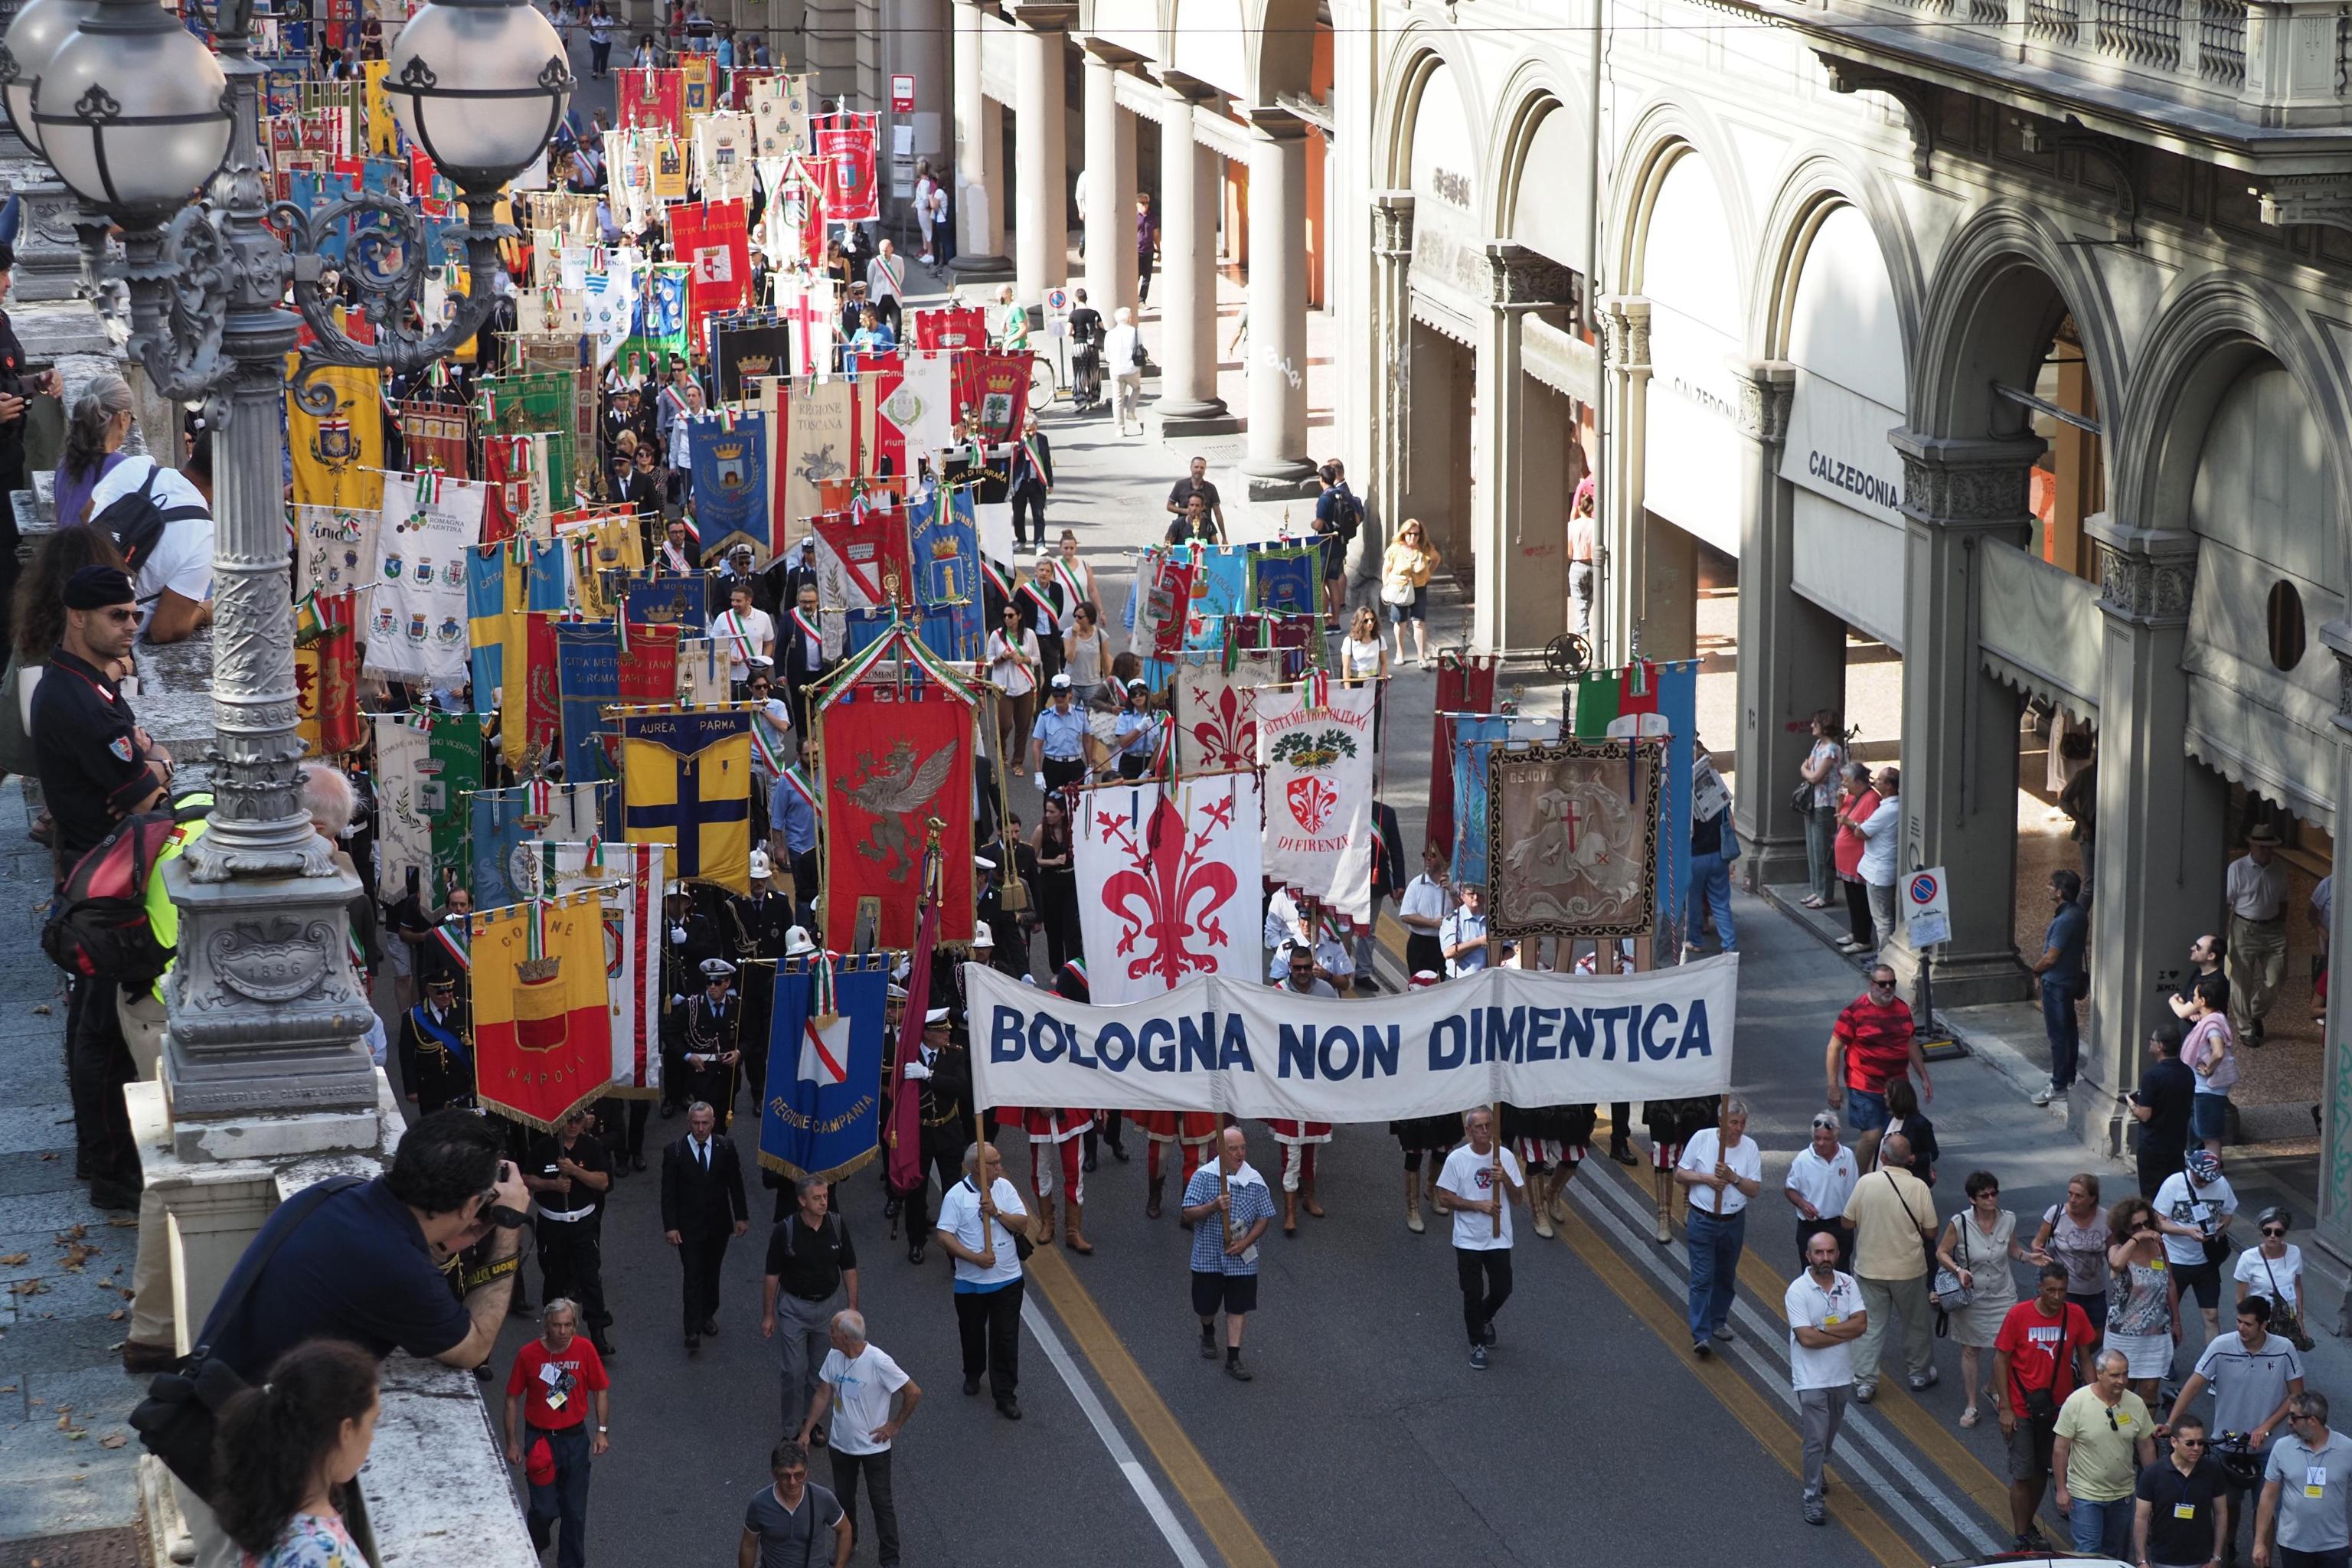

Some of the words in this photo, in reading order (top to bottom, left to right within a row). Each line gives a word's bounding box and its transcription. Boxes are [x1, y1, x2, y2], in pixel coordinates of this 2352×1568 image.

[709, 221, 744, 231] PIACENZA
[799, 403, 841, 416] REGIONE
[797, 419, 842, 431] TOSCANA
[489, 447, 511, 461] COMUN
[950, 472, 965, 484] ITTA
[1808, 450, 1898, 511] CALZEDONIA
[430, 518, 465, 528] ROMAGNA
[954, 511, 974, 529] USSI
[315, 527, 361, 542] unio
[428, 524, 462, 534] FAENTINA
[587, 674, 615, 683] ROMA
[1184, 668, 1210, 684] COMUNE
[640, 722, 676, 733] AUREA
[700, 720, 736, 731] PARMA
[1264, 712, 1292, 735] CITTÀ
[1292, 708, 1367, 731] METROPOLITANA
[446, 739, 479, 757] VICENTINO
[1510, 769, 1554, 783] GENOVA
[1278, 836, 1292, 851] DI
[1295, 834, 1352, 852] FIRENZE
[501, 921, 573, 947] CONE
[248, 962, 300, 978] 1896
[991, 1005, 1254, 1072] BOLOGNA
[1278, 1024, 1400, 1081] NON
[1428, 998, 1713, 1071] DIMENTICA
[508, 1056, 586, 1084] NAPOLI
[769, 1096, 811, 1129] REGIONE
[813, 1095, 874, 1133] CAMPANIA
